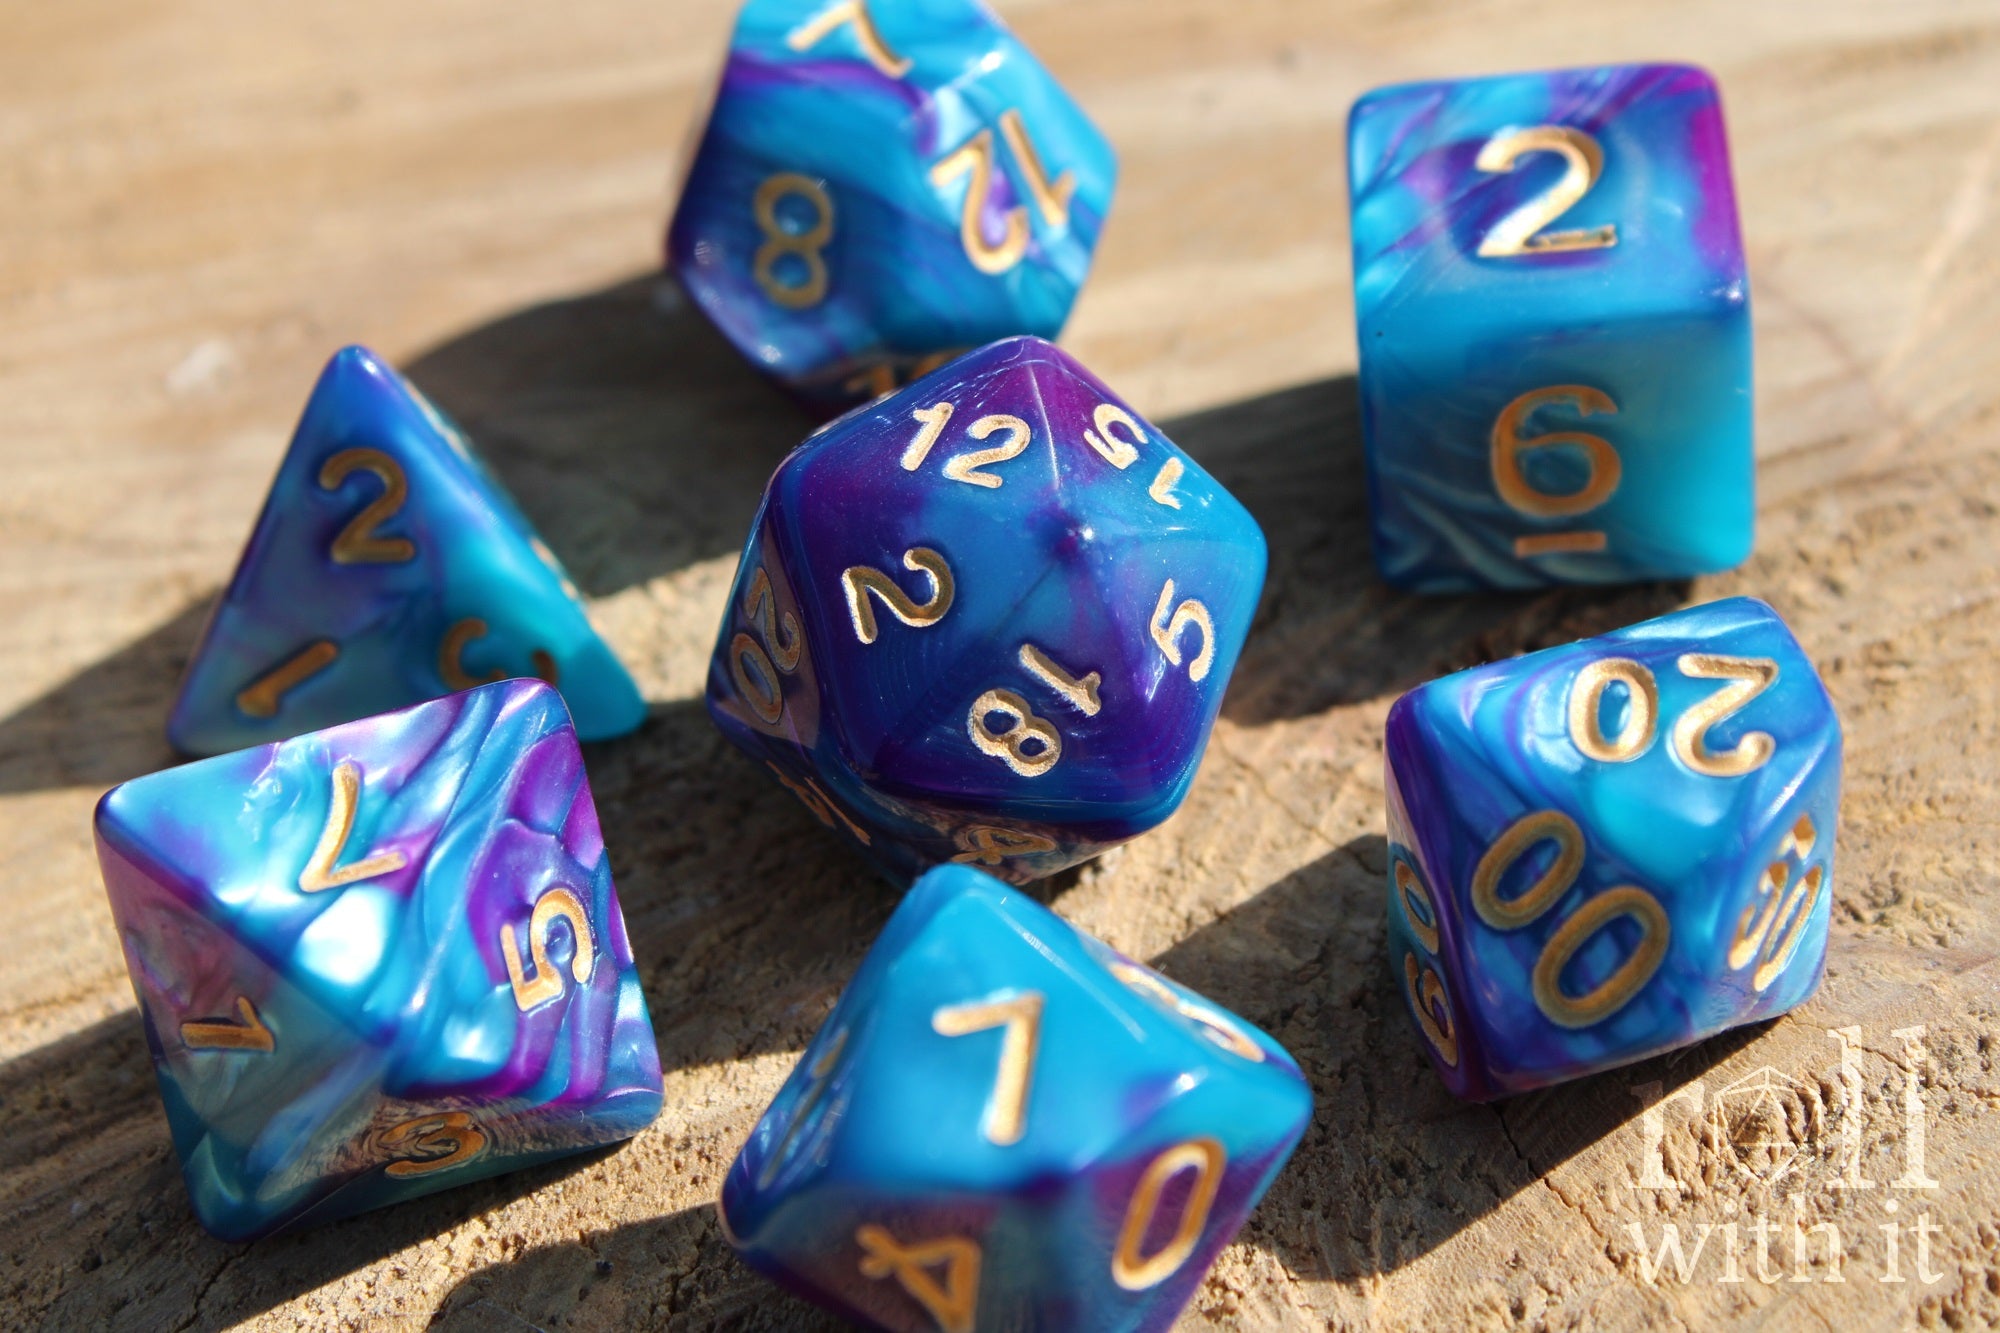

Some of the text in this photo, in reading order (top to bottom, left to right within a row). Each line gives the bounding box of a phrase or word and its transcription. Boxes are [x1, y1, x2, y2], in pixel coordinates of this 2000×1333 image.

[753, 170, 834, 311] 8
[928, 107, 1075, 275] 12
[1475, 125, 1619, 259] 2
[319, 447, 416, 566] 2
[899, 402, 1031, 488] 12
[1083, 403, 1184, 510] 15
[1490, 383, 1622, 518] 6
[732, 566, 801, 725] 20
[841, 547, 955, 645] 2
[1149, 578, 1215, 683] 5
[236, 640, 338, 719] 1
[966, 643, 1102, 778] 18
[1568, 652, 1780, 778] 20
[299, 759, 407, 893] 7
[501, 887, 598, 1013] 5
[1471, 810, 1671, 1029] 00
[181, 997, 275, 1053] 1
[931, 989, 1045, 1148] 7
[379, 1110, 486, 1176] 3
[1111, 1135, 1229, 1291] 0
[856, 1221, 983, 1333] 4
